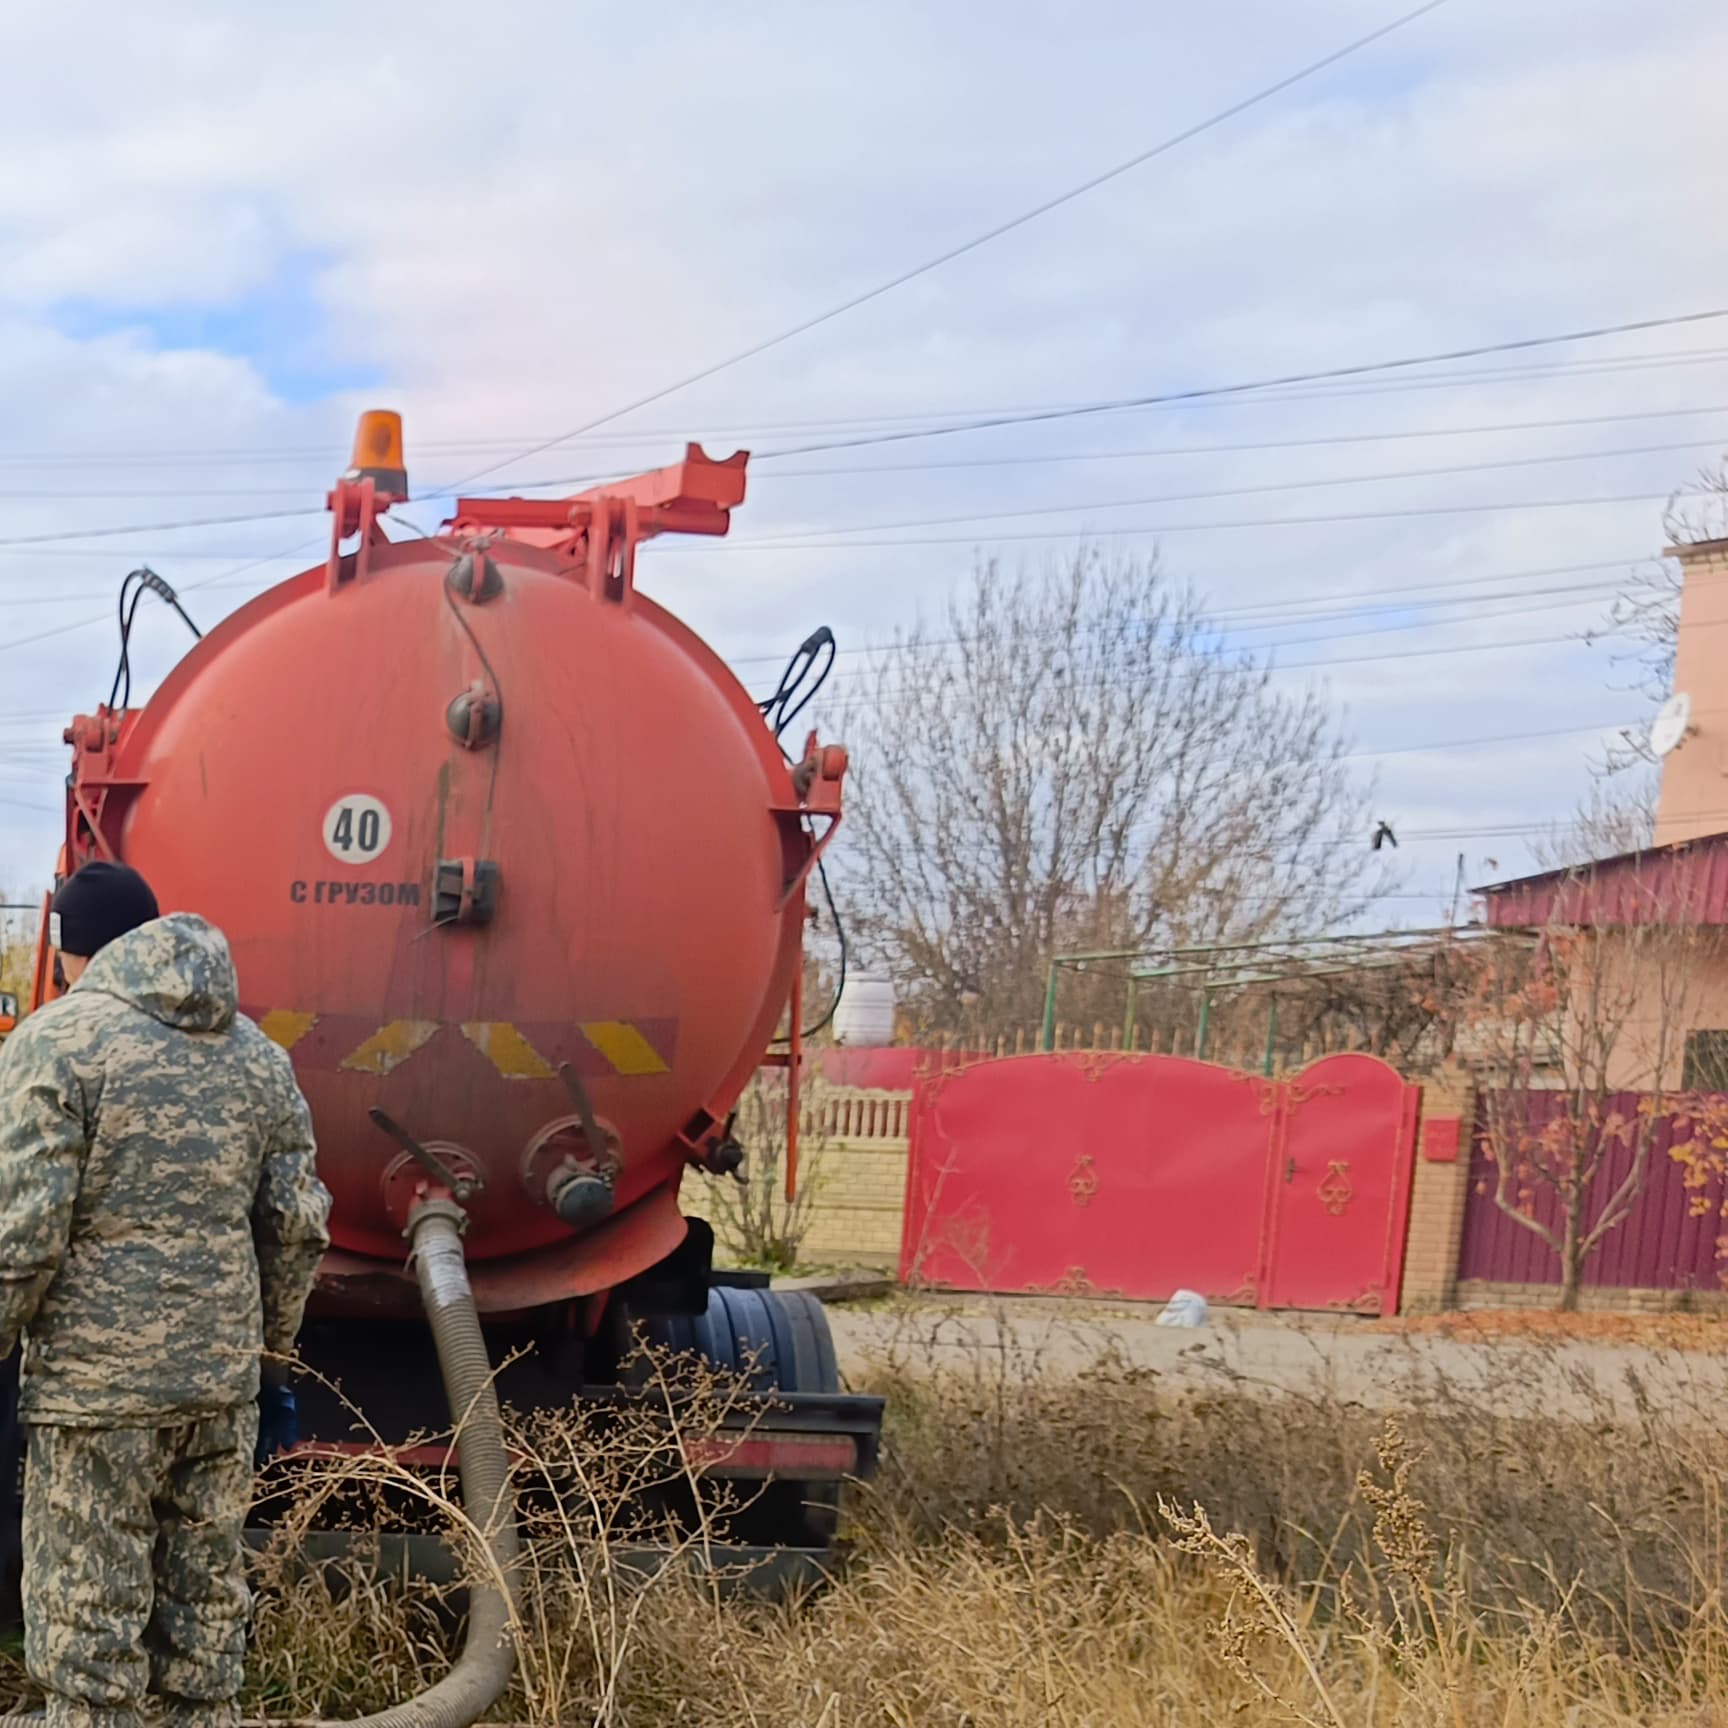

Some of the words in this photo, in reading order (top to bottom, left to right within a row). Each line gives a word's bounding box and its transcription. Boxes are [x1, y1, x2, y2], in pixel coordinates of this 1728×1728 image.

[332, 808, 380, 852] 40
[290, 880, 308, 904] С
[314, 881, 420, 906] ГРУЗОМ
